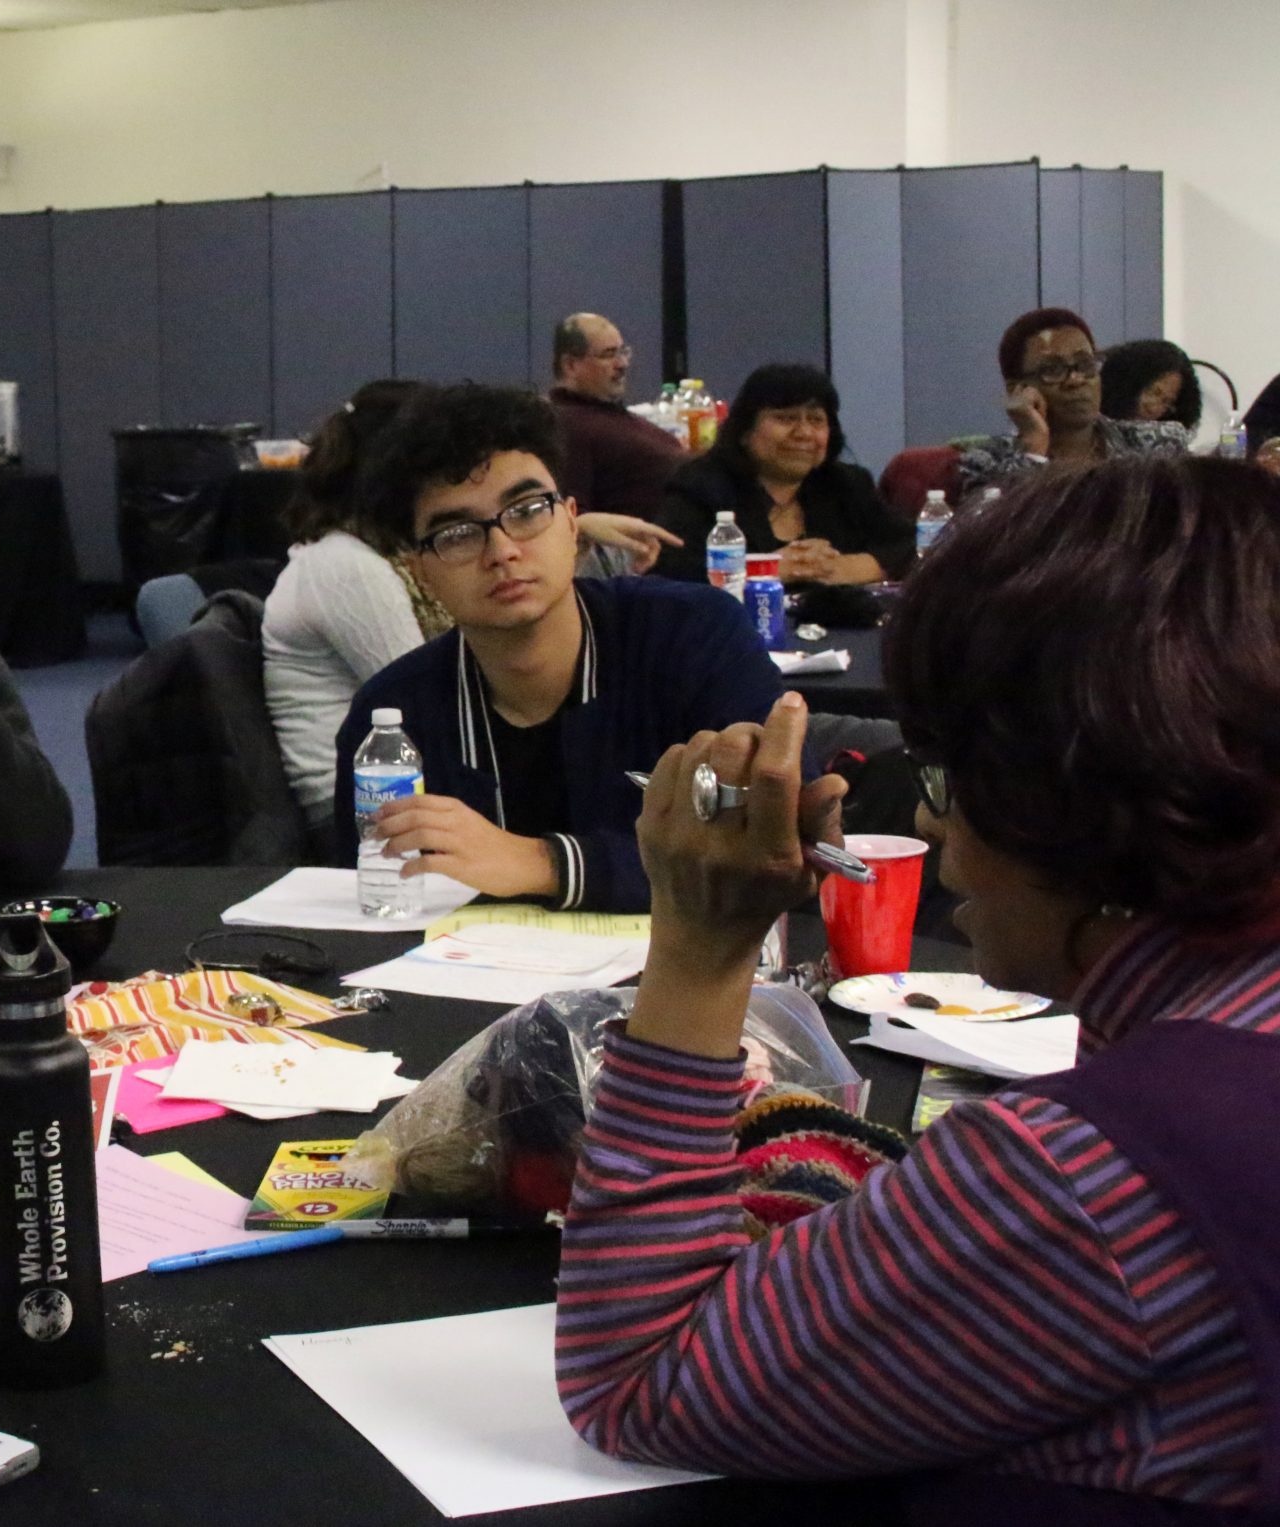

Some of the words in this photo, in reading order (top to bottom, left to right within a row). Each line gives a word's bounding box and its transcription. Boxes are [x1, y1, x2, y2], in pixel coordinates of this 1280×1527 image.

[372, 790, 397, 803] PARK
[12, 1129, 38, 1201] Earth
[40, 1120, 62, 1159] Co.
[45, 1162, 69, 1283] Provision
[304, 1203, 330, 1214] 12
[17, 1206, 43, 1285] Whole
